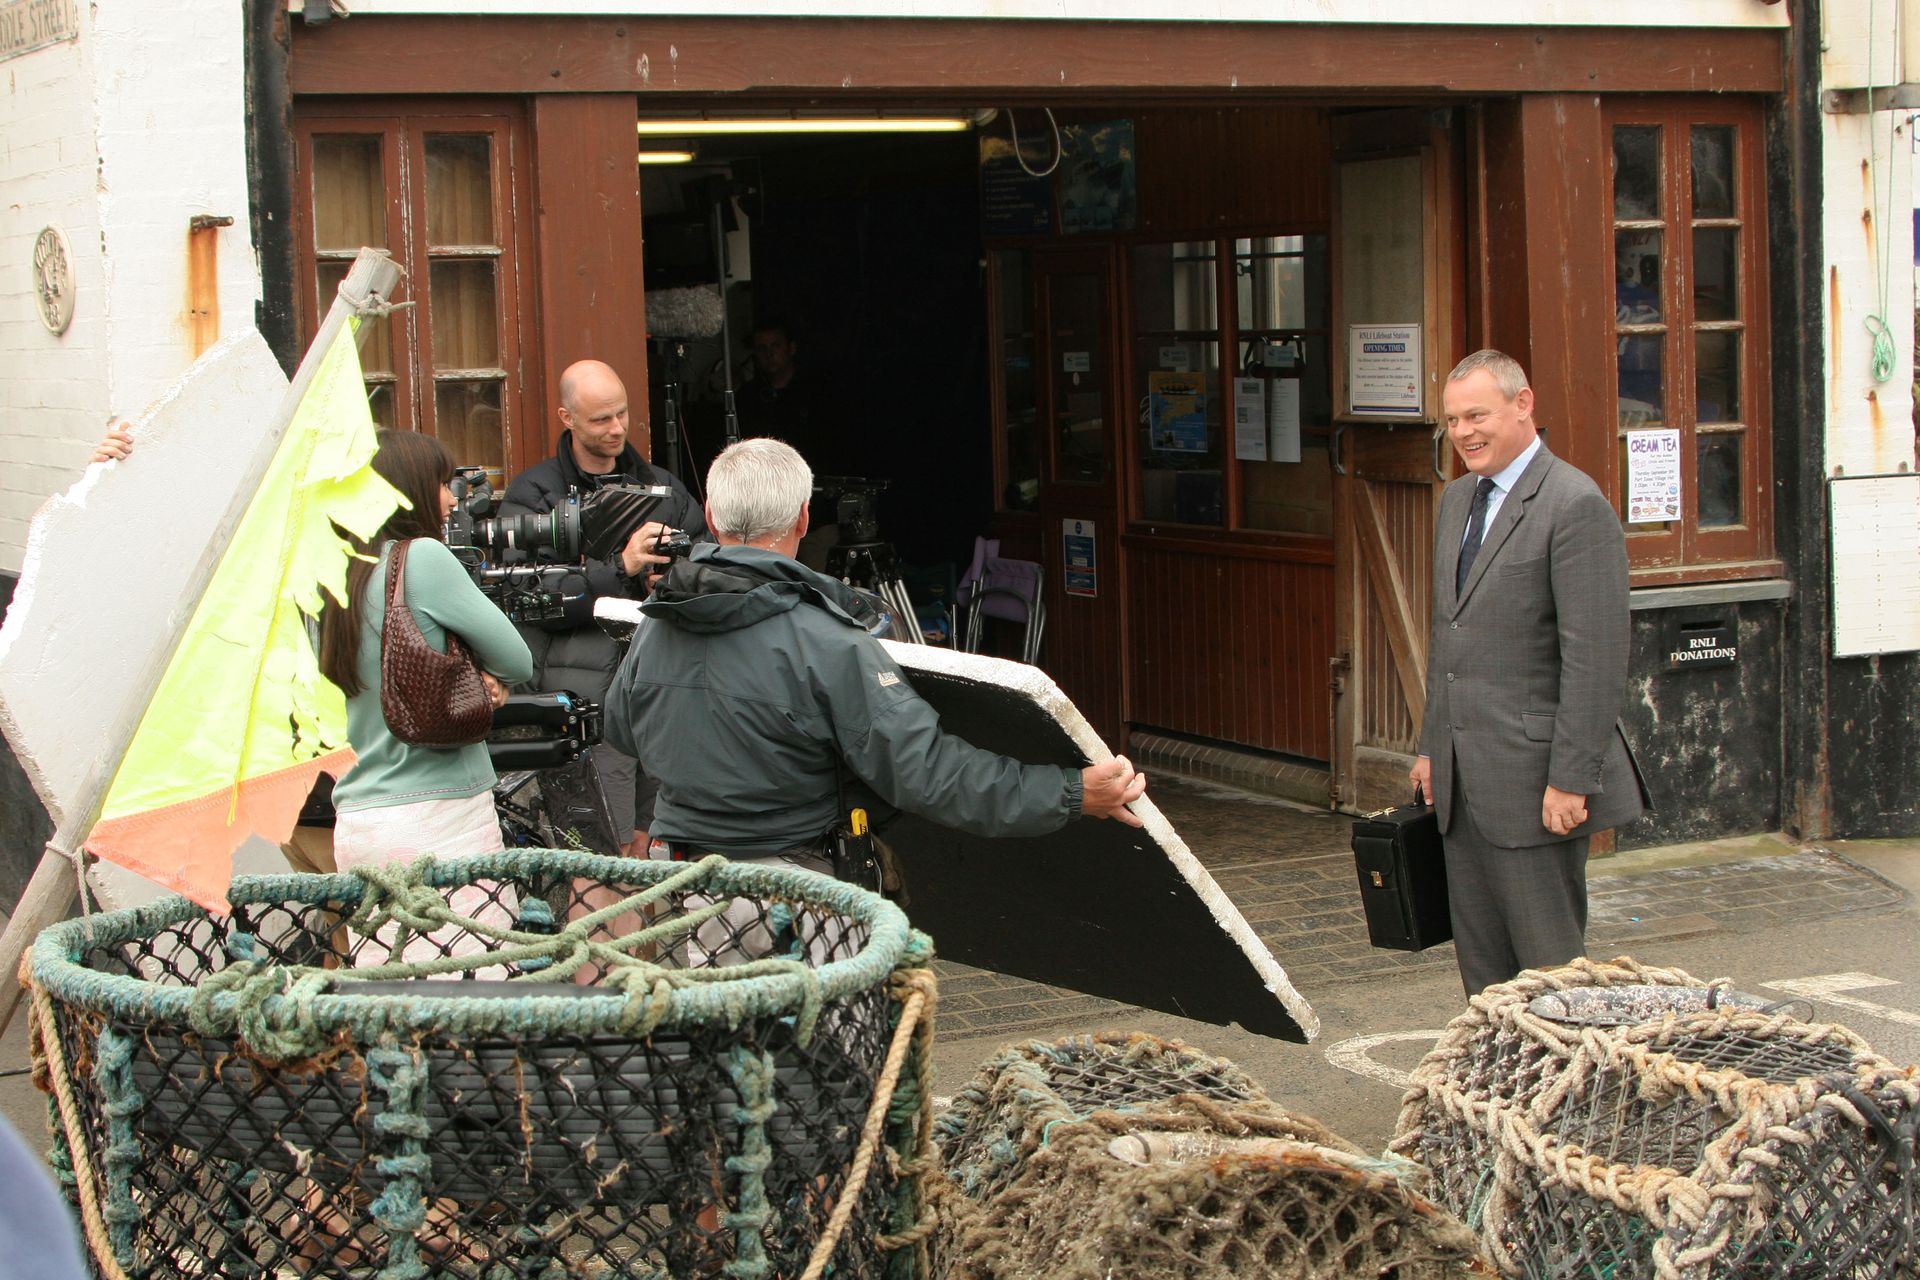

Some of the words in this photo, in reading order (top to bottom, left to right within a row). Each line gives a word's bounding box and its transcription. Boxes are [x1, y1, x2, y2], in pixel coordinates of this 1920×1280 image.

[1364, 343, 1388, 352] OPENING
[1388, 343, 1405, 351] TIMES
[1630, 438, 1659, 453] CREAM
[1661, 437, 1677, 452] TEA
[1689, 637, 1717, 649] RNLI
[1670, 647, 1736, 661] DONATIONS
